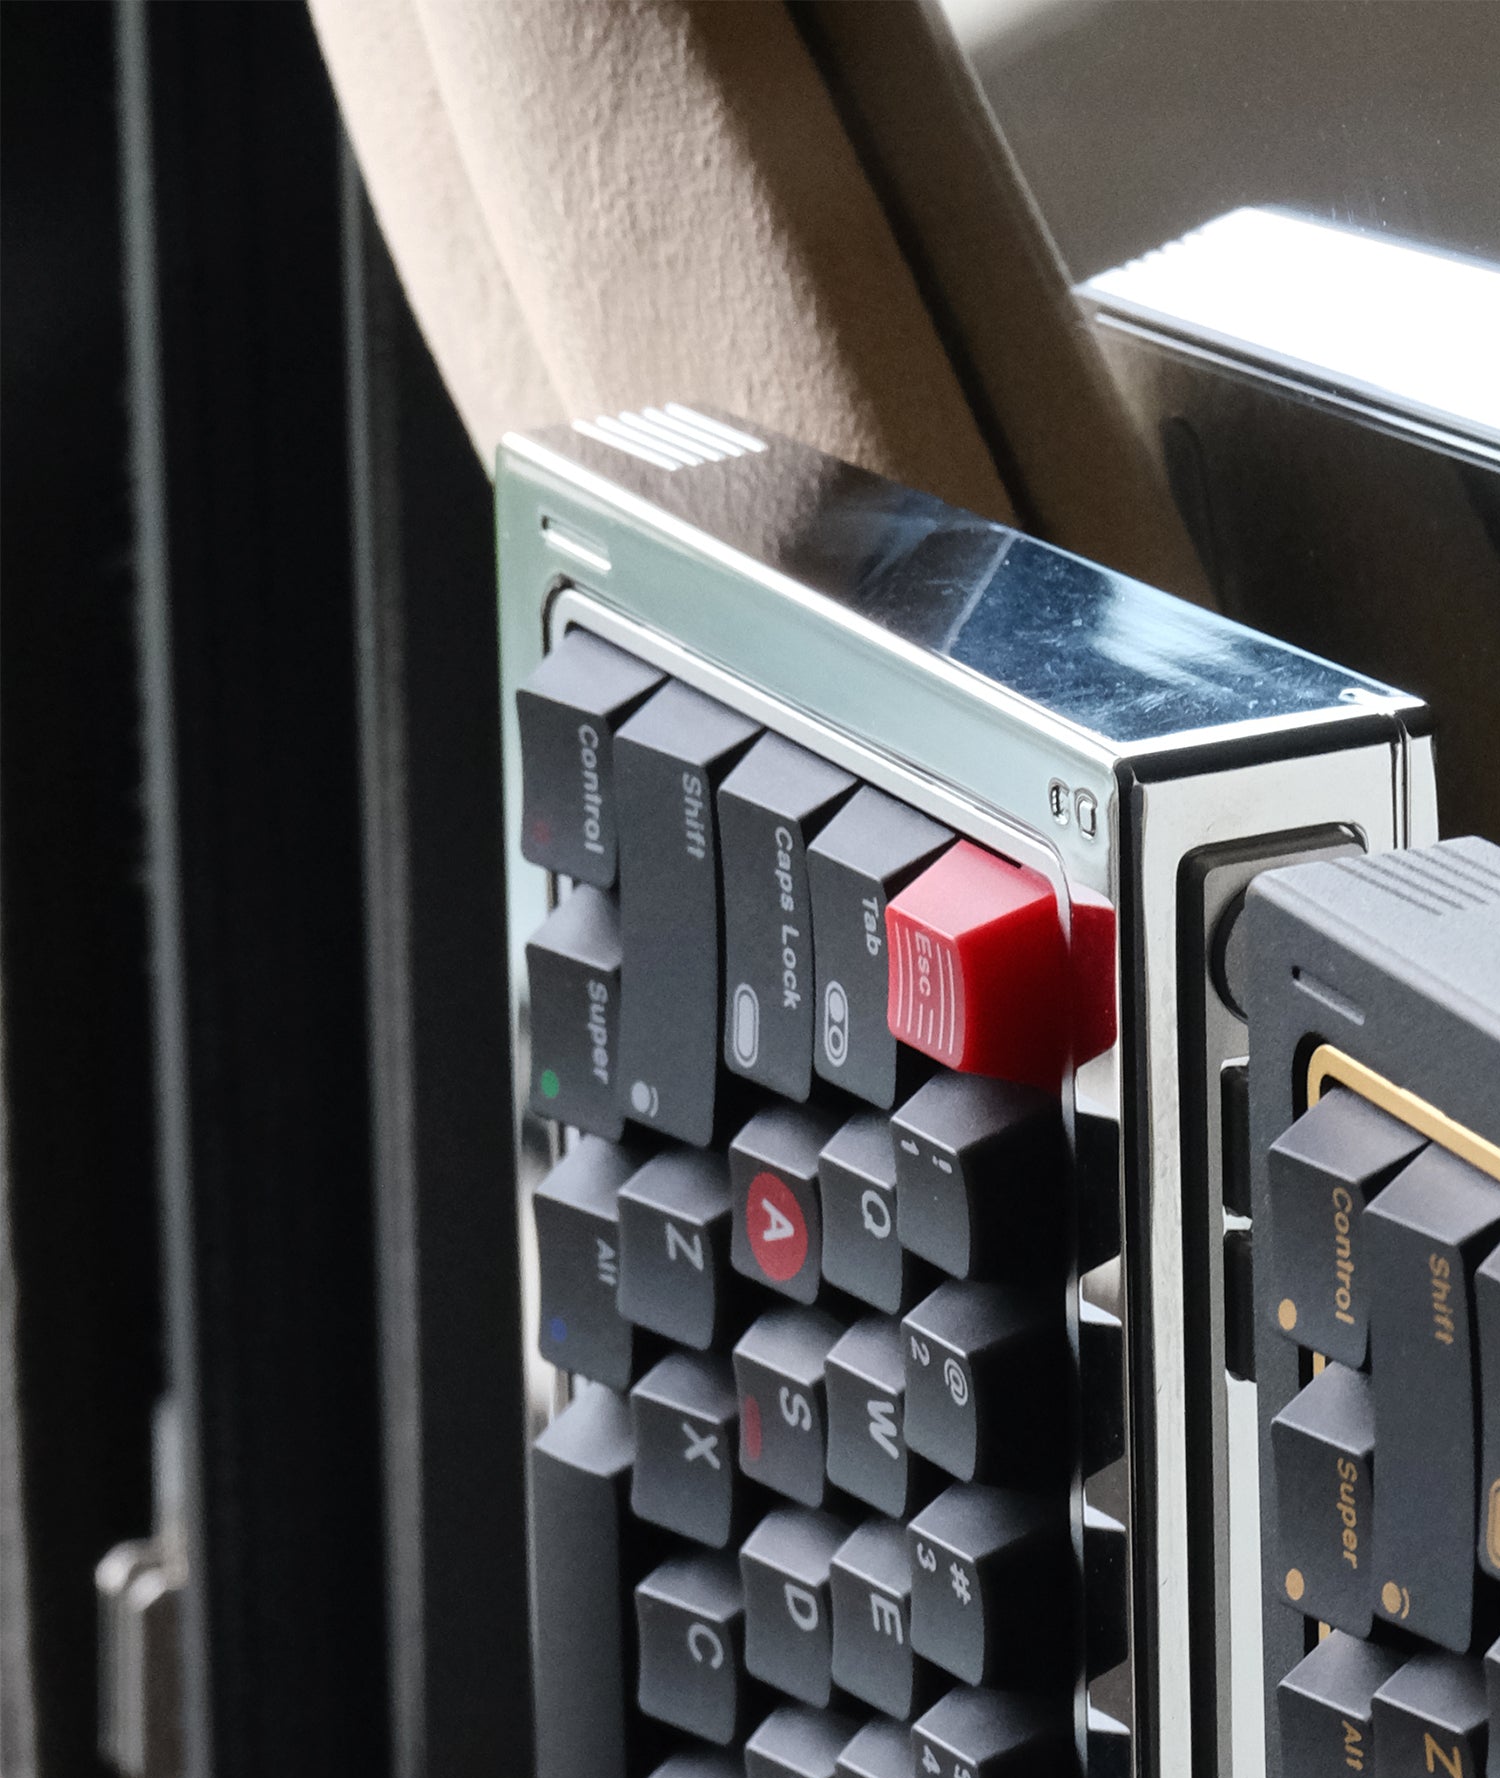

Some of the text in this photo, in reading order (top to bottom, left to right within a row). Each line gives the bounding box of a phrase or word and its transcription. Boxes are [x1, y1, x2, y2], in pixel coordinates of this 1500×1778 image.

[579, 725, 604, 854] Control
[683, 773, 705, 858] Shift
[775, 827, 801, 1009] Caps Lock
[862, 898, 881, 955] Tab
[915, 932, 931, 996] Esc
[588, 981, 608, 1084] Super
[901, 1140, 919, 1155] 1
[933, 1156, 952, 1173] !
[762, 1199, 794, 1242] A
[862, 1190, 890, 1238] Q
[597, 1239, 616, 1285] Alt
[666, 1223, 703, 1270] Z
[1333, 1188, 1355, 1324] Control
[1429, 1254, 1454, 1344] Shift
[911, 1336, 929, 1365] 2
[944, 1358, 968, 1406] @
[780, 1387, 811, 1431] S
[867, 1400, 899, 1459] W
[683, 1423, 720, 1469] X
[1337, 1459, 1357, 1569] Super
[917, 1543, 936, 1571] 3
[785, 1583, 818, 1631] D
[950, 1563, 971, 1604] #
[871, 1594, 903, 1644] E
[688, 1622, 723, 1669] C
[922, 1746, 940, 1774] 4
[1343, 1721, 1363, 1770] Alt
